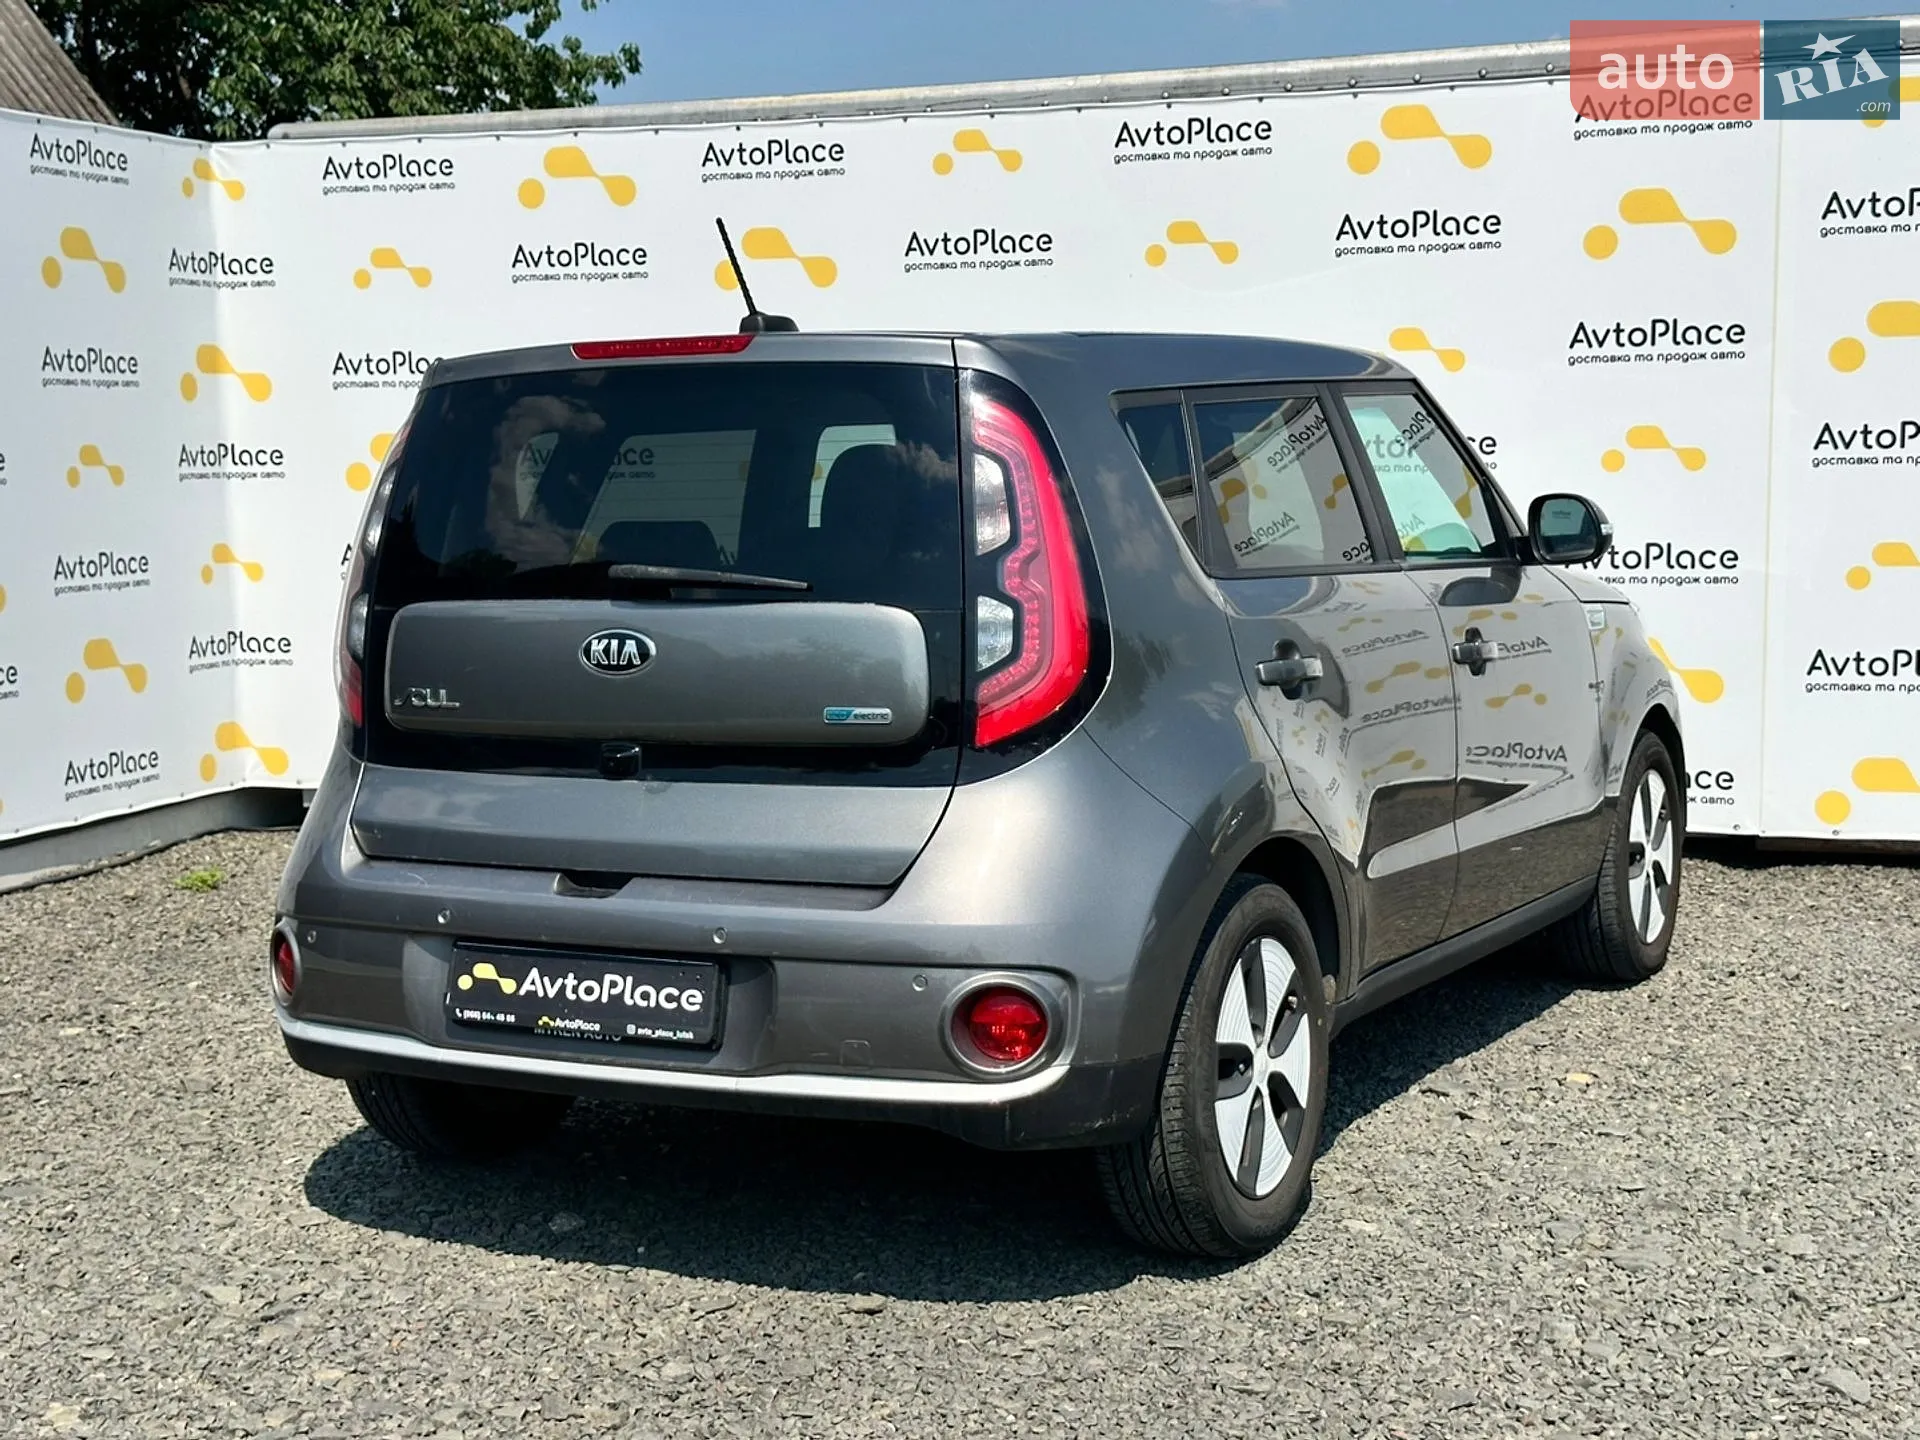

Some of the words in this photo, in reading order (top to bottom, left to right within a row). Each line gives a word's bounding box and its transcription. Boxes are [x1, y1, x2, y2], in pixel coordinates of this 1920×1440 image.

[1114, 117, 1273, 148] AvtoPlace
[1573, 128, 1637, 140] доставка
[1641, 124, 1660, 133] та
[1664, 122, 1714, 135] продаж
[1717, 120, 1753, 129] авто
[30, 132, 129, 171] AvtoPlace
[701, 139, 845, 167] AvtoPlace
[1113, 152, 1170, 165] доставка
[1173, 150, 1190, 160] та
[1192, 147, 1239, 162] продаж
[1241, 146, 1273, 156] авто
[323, 154, 454, 180] AvtoPlace
[1335, 209, 1502, 241] AvtoPlace
[1820, 224, 1887, 239] доставка
[1890, 223, 1911, 233] та
[511, 241, 648, 268] AvtoPlace
[904, 228, 1053, 257] AvtoPlace
[1334, 245, 1394, 258] доставка
[1396, 243, 1415, 253] та
[1418, 241, 1466, 255] продаж
[1468, 240, 1502, 250] авто
[169, 248, 274, 275] AvtoPlace
[1568, 318, 1746, 350] AvtoPlace
[42, 345, 138, 374] AvtoPlace
[1568, 354, 1631, 367] доставка
[1634, 353, 1654, 363] та
[1656, 352, 1707, 366] продаж
[1710, 350, 1746, 361] авто
[1813, 421, 1920, 450] AvtoP
[179, 443, 284, 467] AvtoPlace
[1812, 456, 1879, 469] доставка
[1882, 455, 1904, 464] та
[54, 552, 149, 580] AvtoPlace
[1565, 543, 1739, 569] vtoPlace
[1629, 576, 1648, 584] та
[1651, 576, 1701, 587] продаж
[1704, 576, 1739, 584] авто
[189, 631, 292, 659] AvtoPlace
[590, 638, 641, 665] KIA
[1804, 683, 1871, 694] доставка
[1874, 683, 1896, 692] та
[64, 749, 159, 786] AvtoPlace
[1700, 796, 1735, 805] авто
[519, 967, 703, 1012] AvtoPlace
[555, 1017, 600, 1032] AvtoPlace
